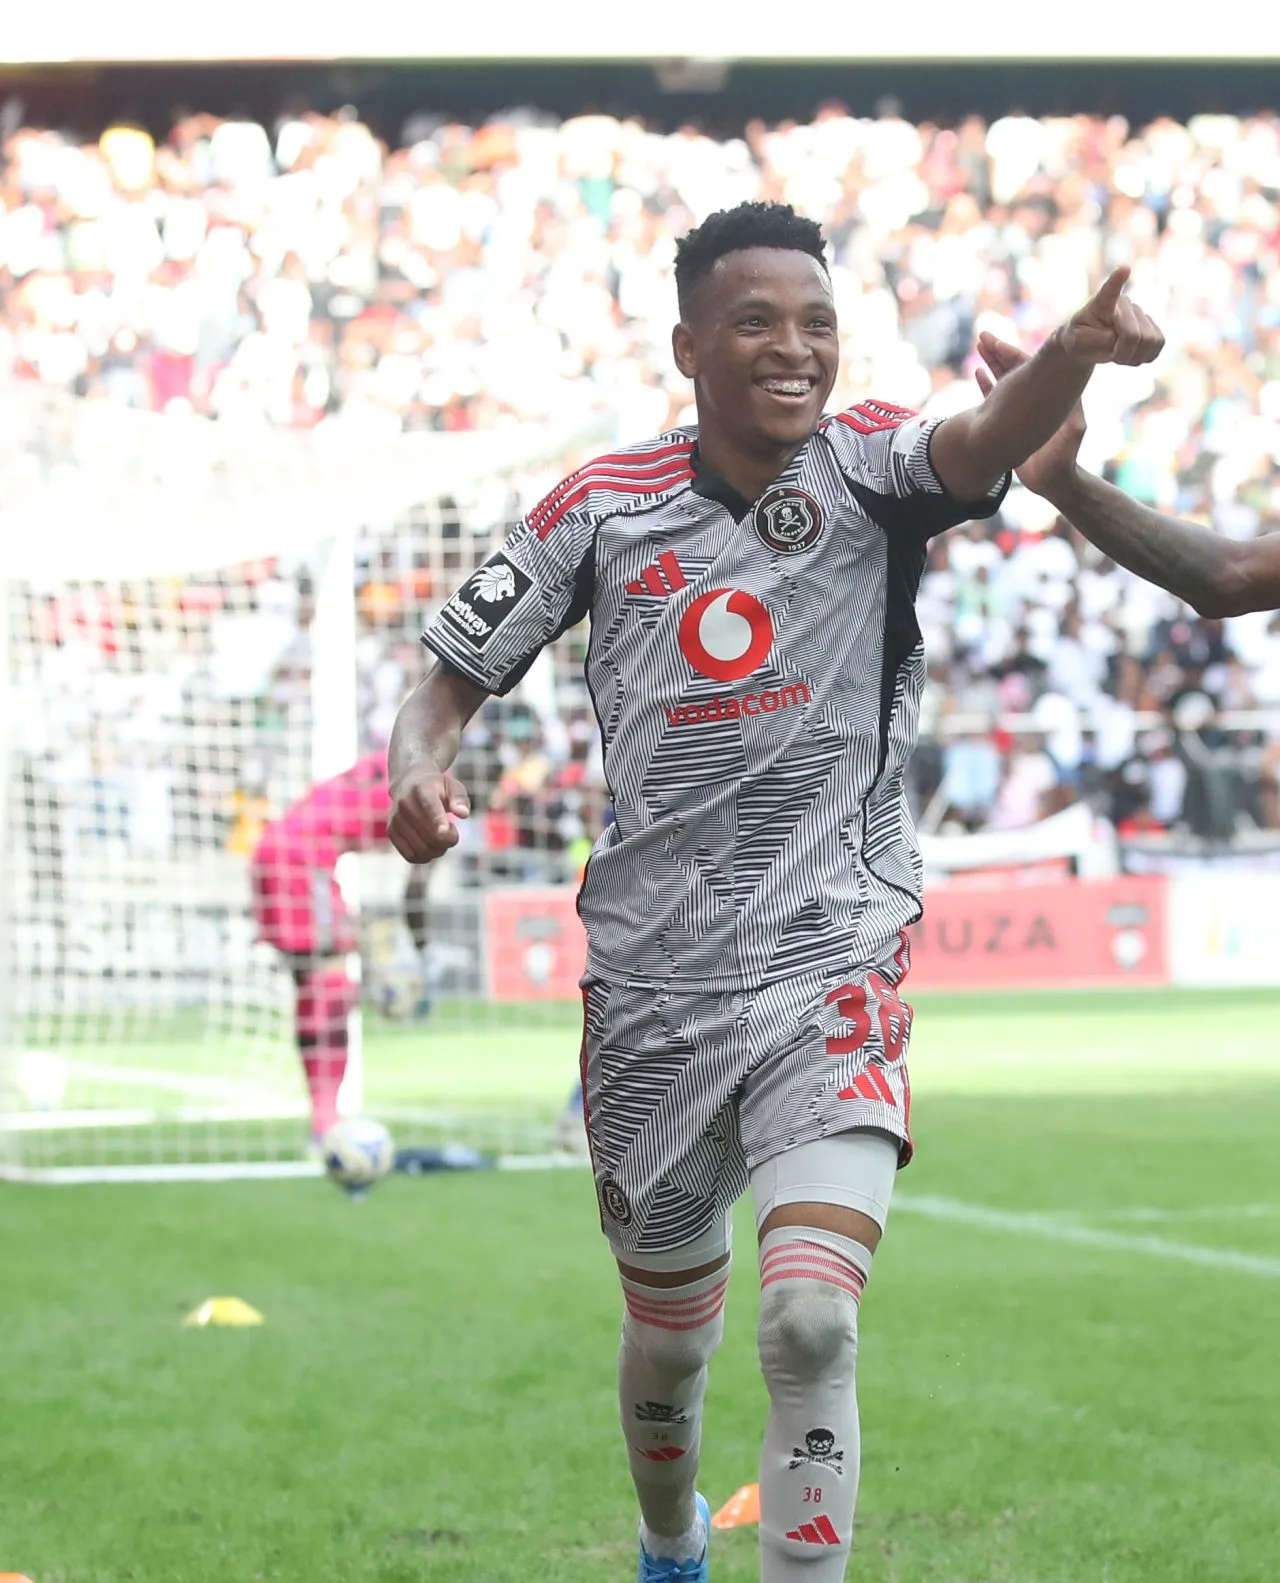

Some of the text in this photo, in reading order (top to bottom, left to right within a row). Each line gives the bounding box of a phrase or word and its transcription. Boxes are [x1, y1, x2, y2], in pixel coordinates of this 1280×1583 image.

[787, 541, 806, 551] 1937
[449, 592, 493, 637] betway
[663, 682, 811, 727] vodacom
[825, 971, 906, 1062] 38
[802, 1485, 823, 1503] 38
